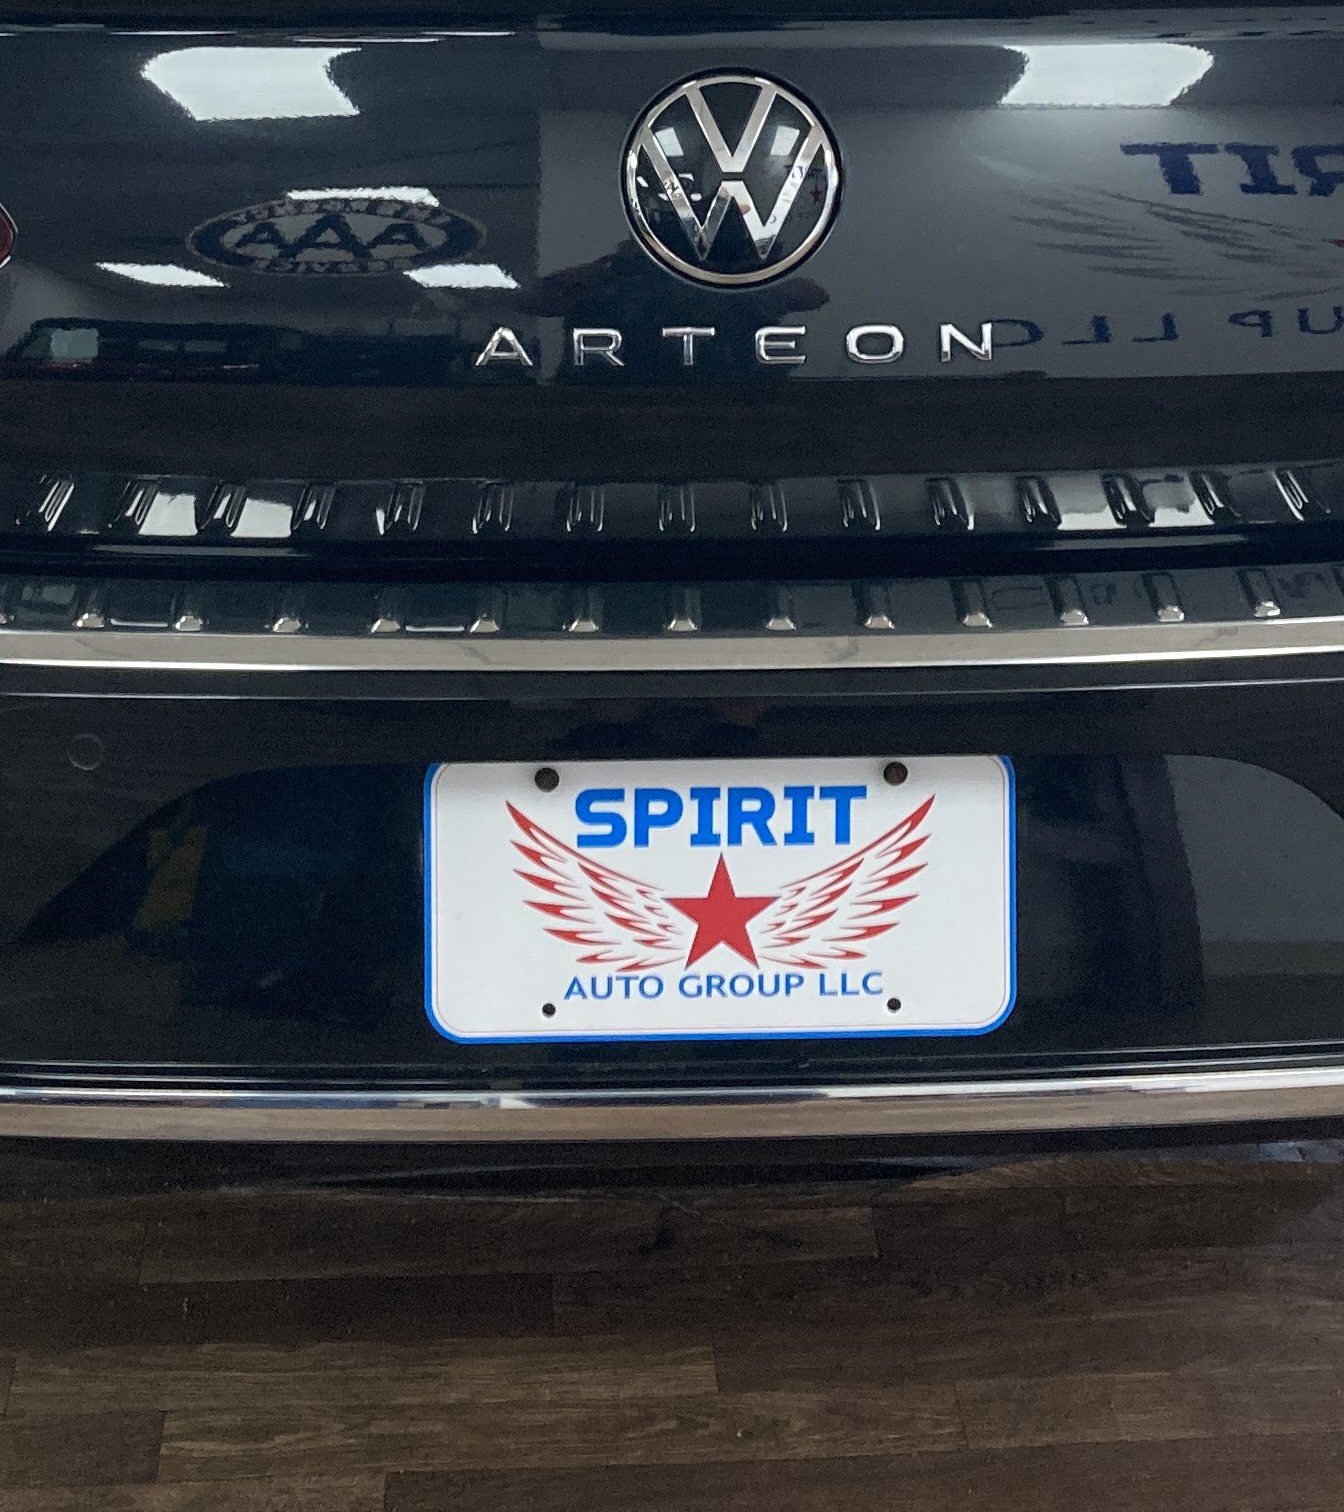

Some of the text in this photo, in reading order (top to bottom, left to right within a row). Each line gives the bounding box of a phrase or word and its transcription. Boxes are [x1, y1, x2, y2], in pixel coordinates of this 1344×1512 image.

[475, 322, 994, 367] ARTEON
[575, 785, 867, 849] SPIRIT
[564, 971, 884, 1001] AUTO GROUP LLC
